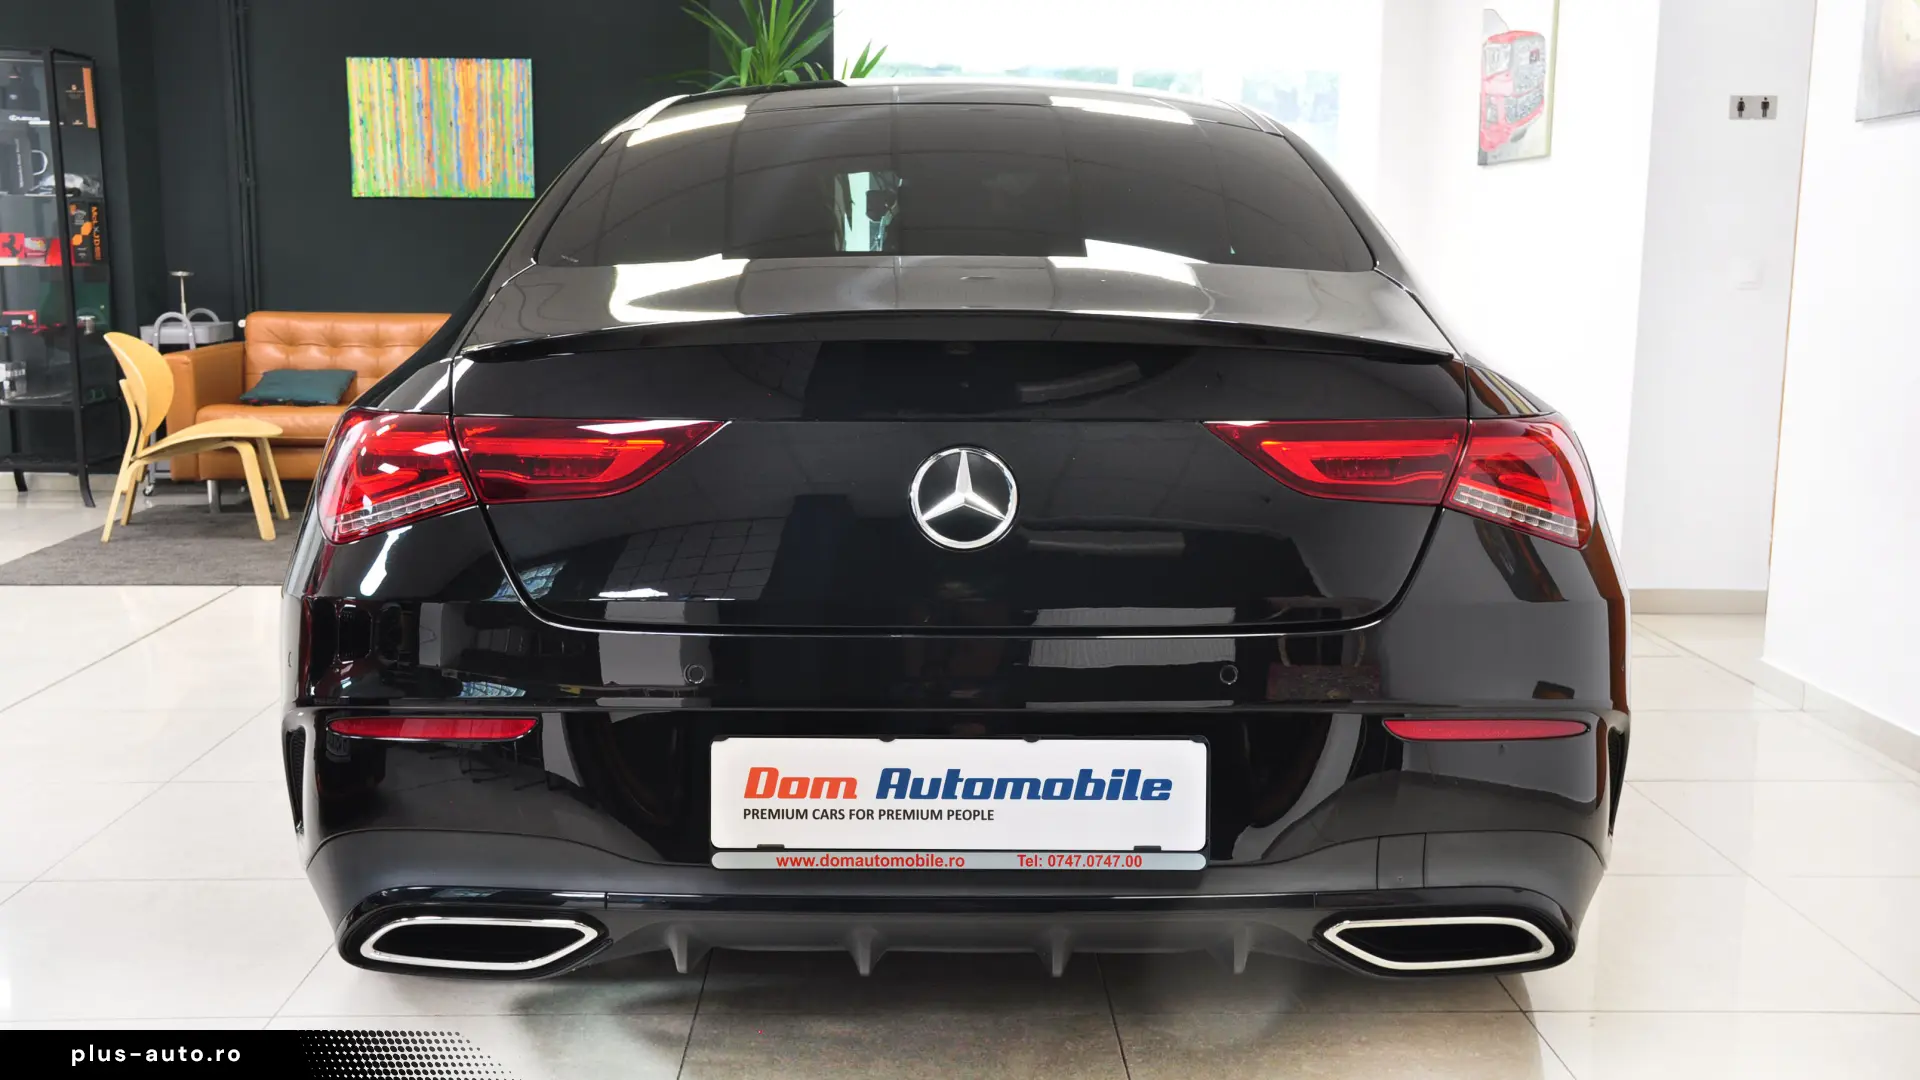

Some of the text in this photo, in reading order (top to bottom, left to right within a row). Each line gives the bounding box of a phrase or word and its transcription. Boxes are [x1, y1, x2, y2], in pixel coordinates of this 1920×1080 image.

[743, 766, 1173, 801] Dom Automobile
[743, 808, 995, 821] PREMIUM CARS FOR PREMIUM PEOPLE
[775, 853, 965, 868] www.domautomobile.ro
[1018, 853, 1143, 868] Tel: 0747.0747.00
